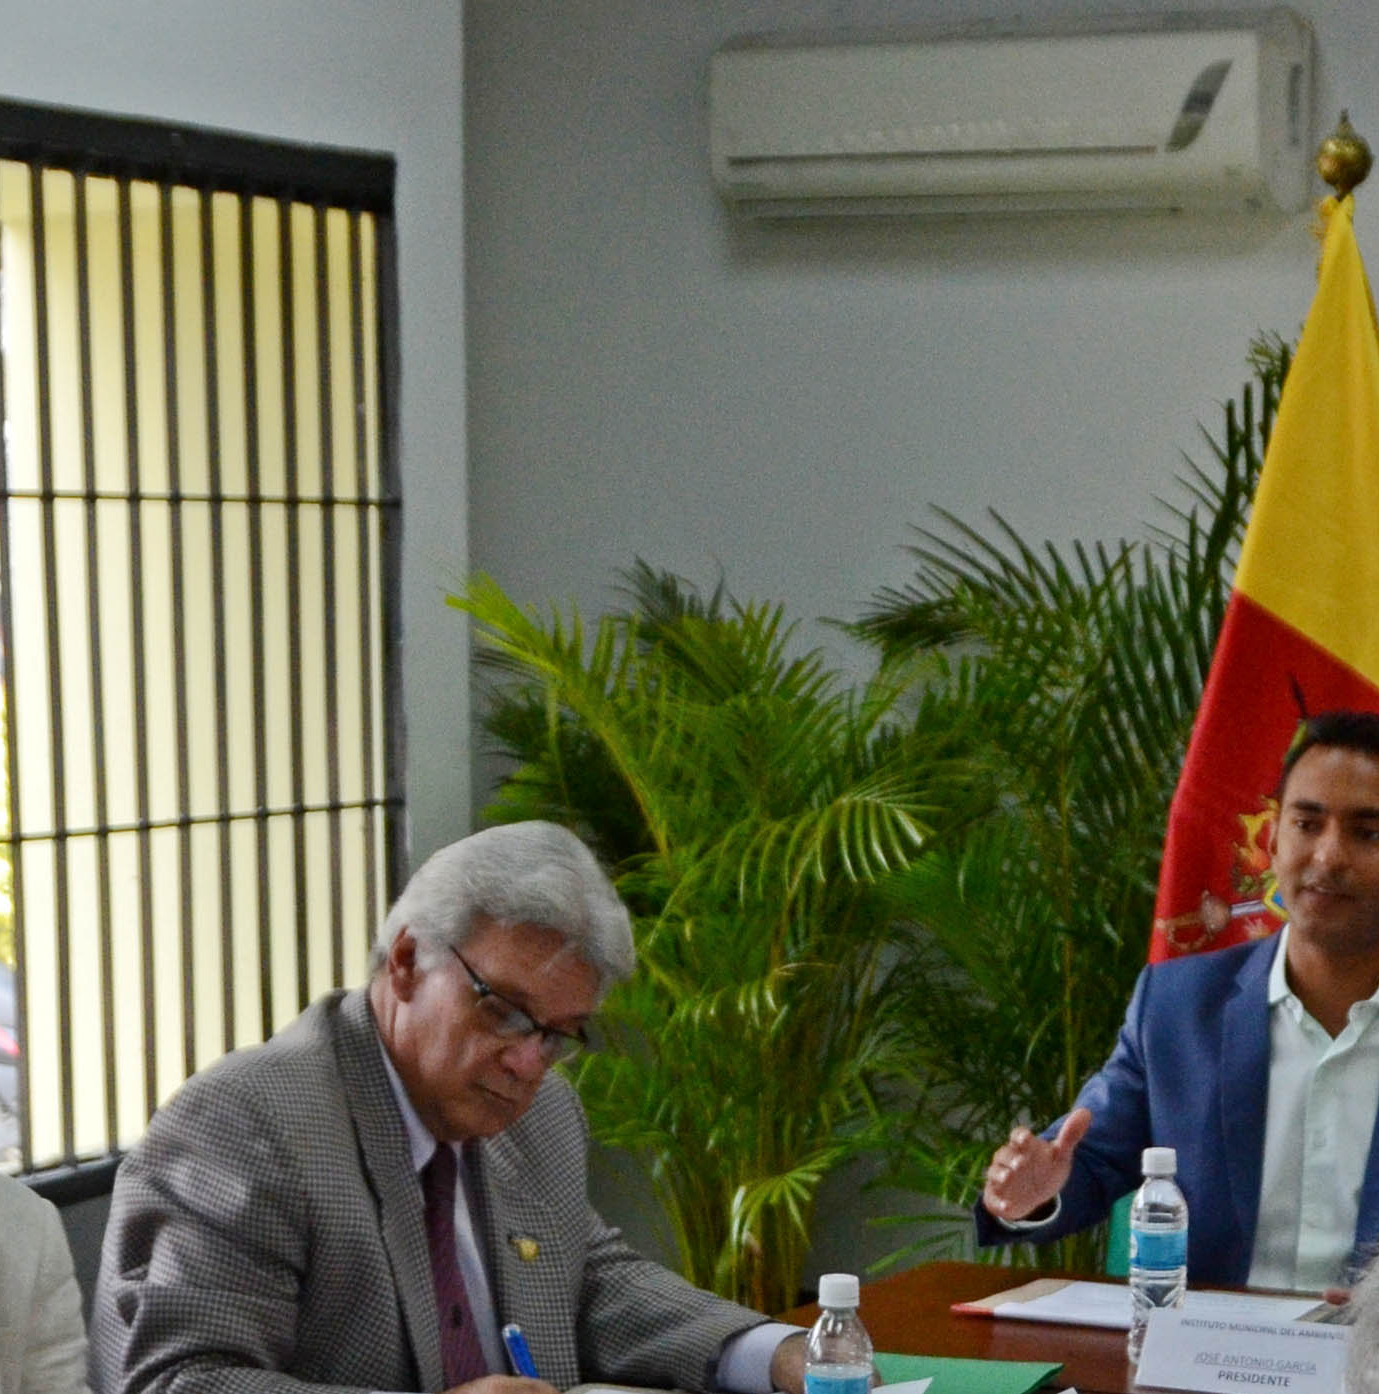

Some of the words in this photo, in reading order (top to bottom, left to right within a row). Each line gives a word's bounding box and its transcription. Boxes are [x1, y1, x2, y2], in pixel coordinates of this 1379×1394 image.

[1181, 1319, 1227, 1330] INSTITUTO
[1228, 1323, 1277, 1335] MUNICIPAL
[1222, 1355, 1275, 1371] ANTONIO
[1218, 1371, 1291, 1387] PRESIDENTE
